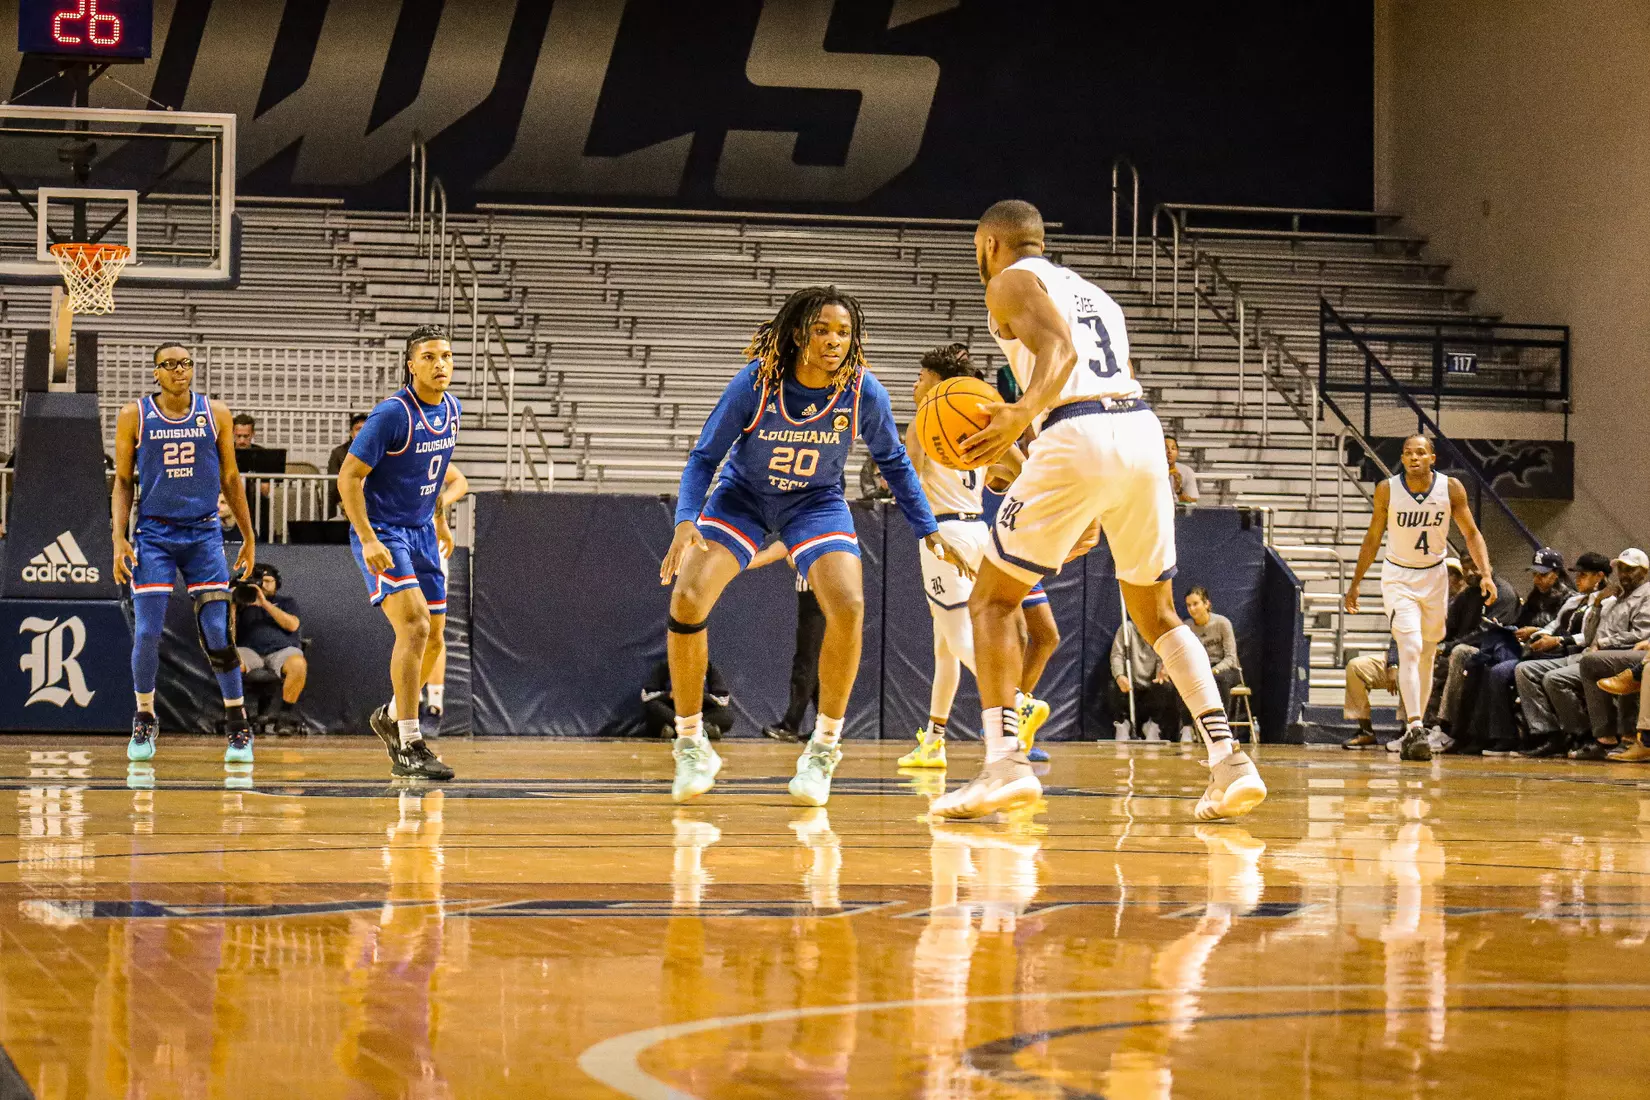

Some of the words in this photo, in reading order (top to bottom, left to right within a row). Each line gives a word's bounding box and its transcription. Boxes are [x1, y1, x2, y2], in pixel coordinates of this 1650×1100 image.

[54, 0, 119, 44] 26
[1077, 315, 1122, 378] 3
[1453, 356, 1472, 371] 117
[149, 427, 207, 440] LOUISIANA
[758, 429, 840, 445] LOUISIANA
[163, 441, 195, 465] 22
[768, 446, 820, 477] 20
[166, 467, 193, 479] TECH
[428, 454, 443, 480] 0
[1396, 511, 1445, 528] OWLS
[1414, 530, 1430, 555] 4
[22, 562, 100, 583] adidas
[19, 615, 96, 707] R
